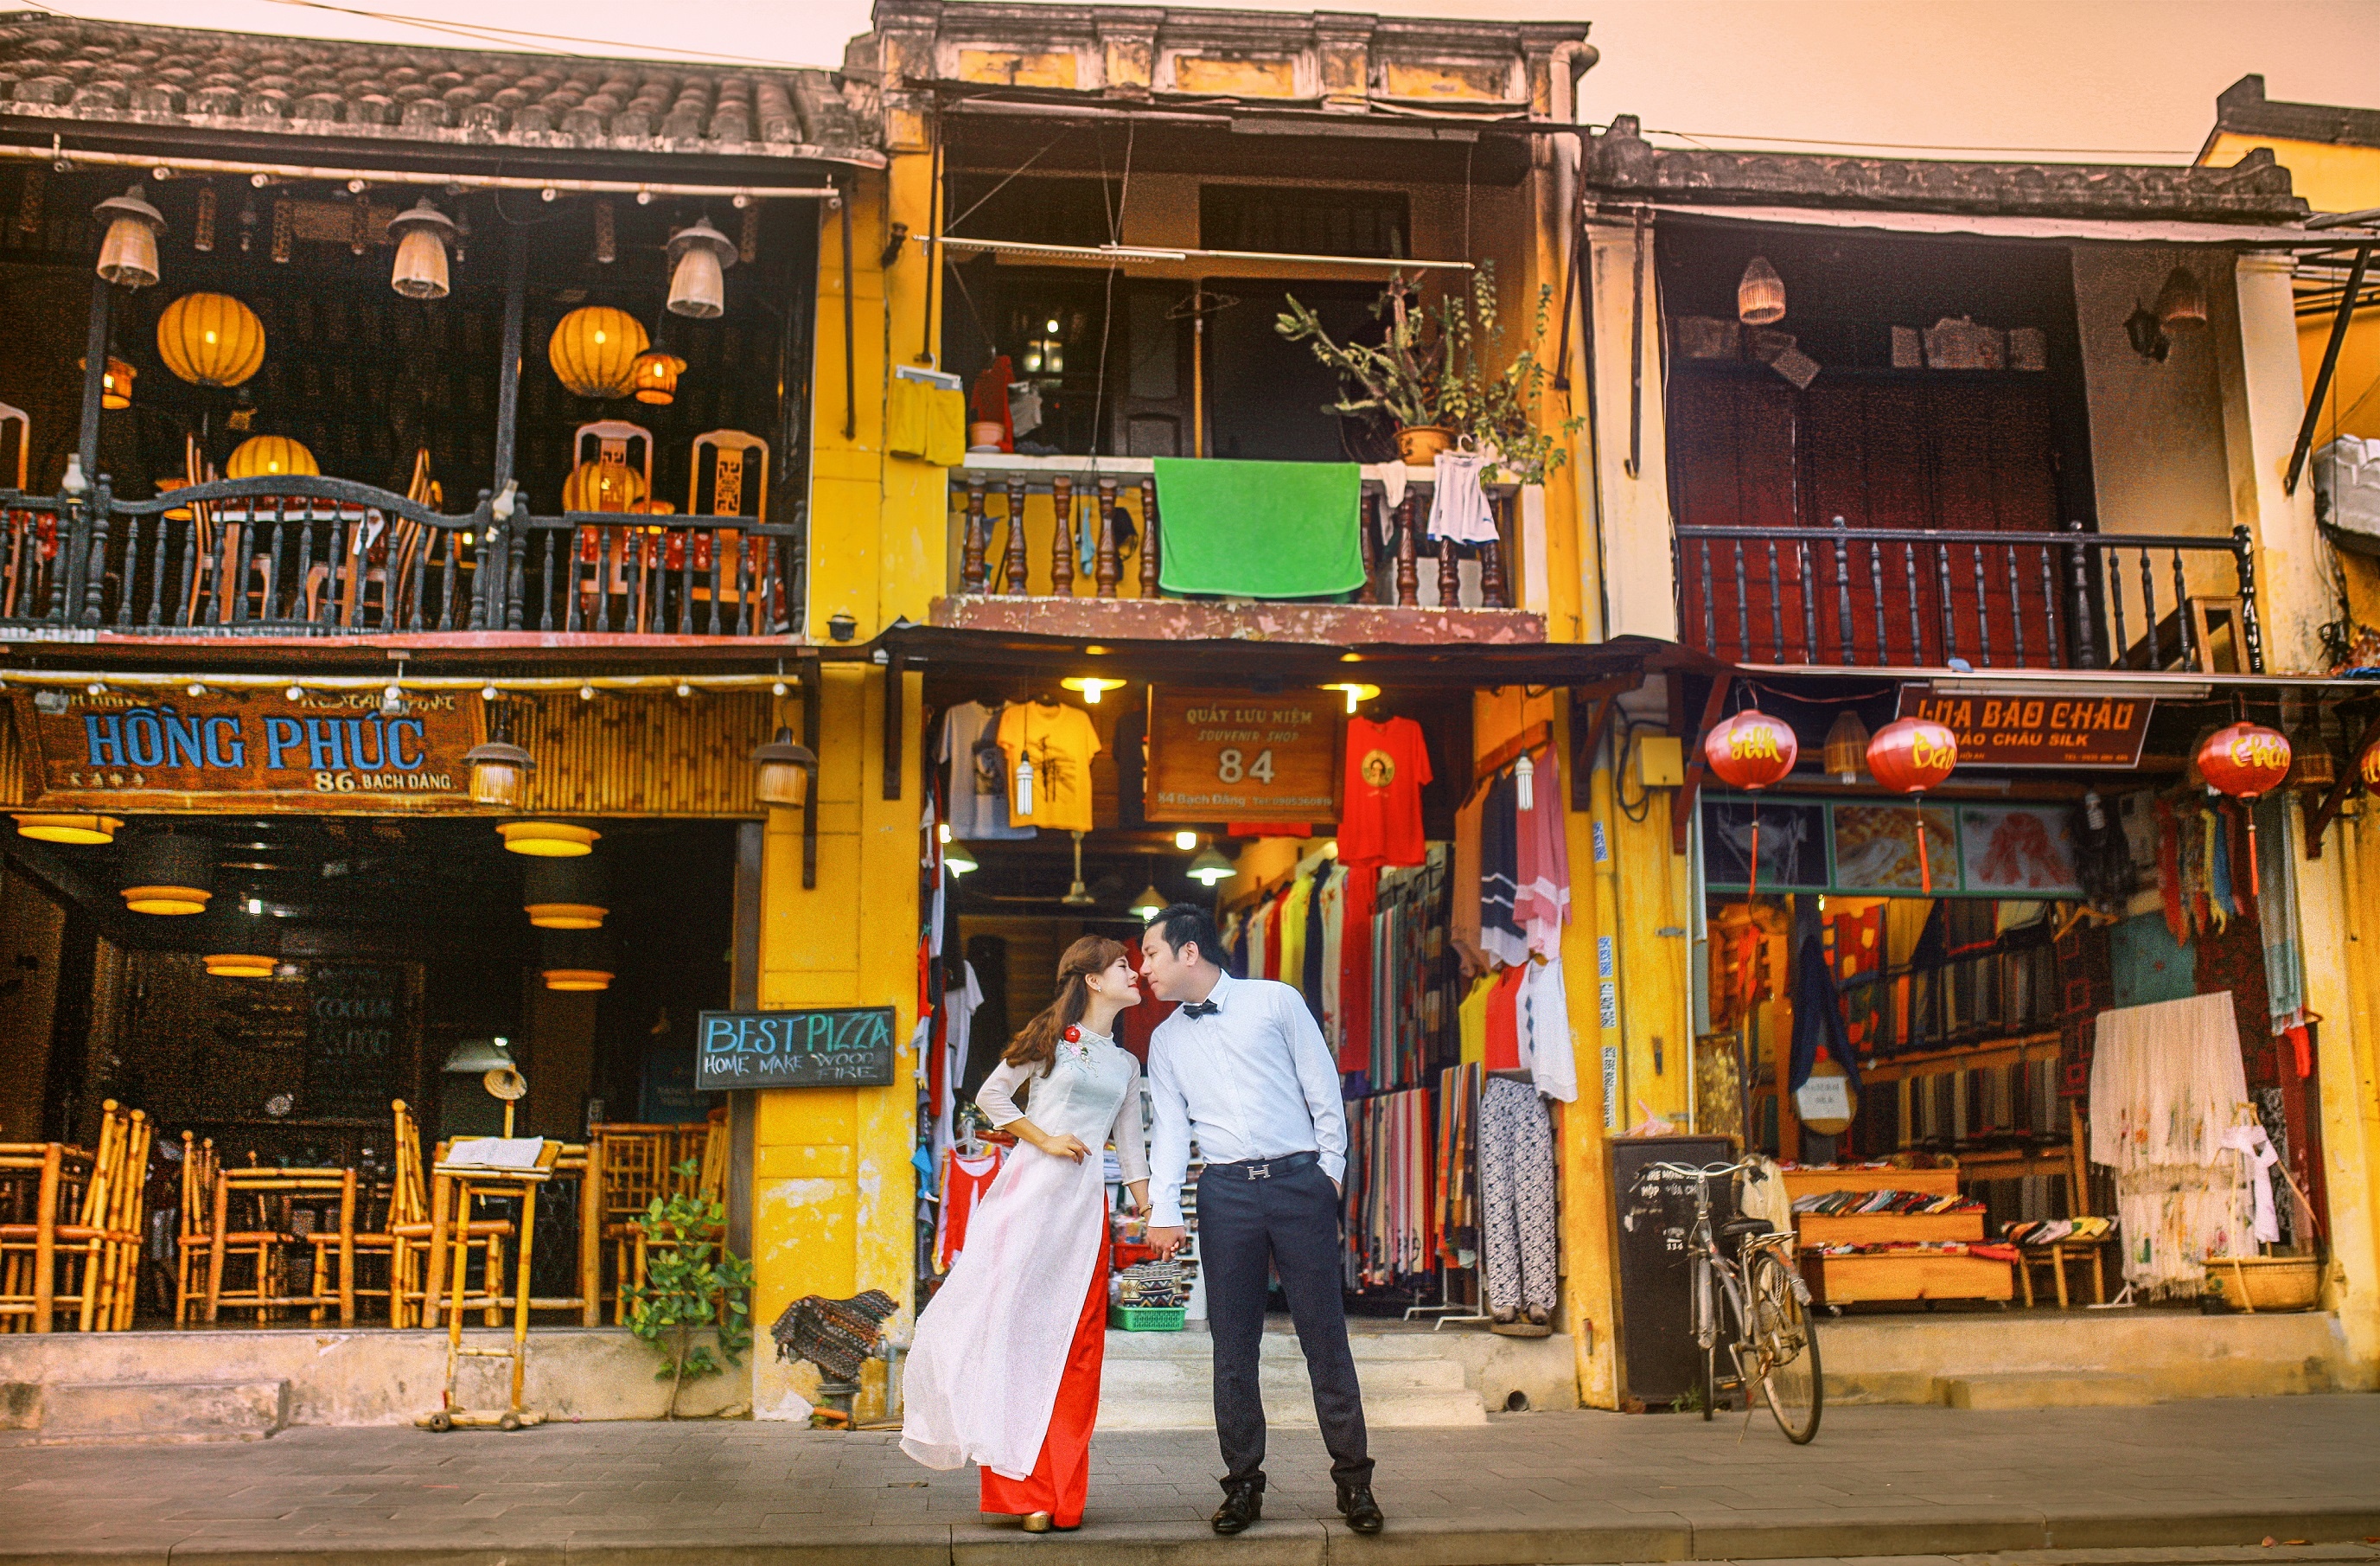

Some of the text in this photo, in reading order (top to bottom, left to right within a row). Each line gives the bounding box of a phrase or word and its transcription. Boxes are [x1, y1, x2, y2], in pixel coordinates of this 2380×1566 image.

[84, 706, 424, 770] HỒNG PHÚC
[1198, 731, 1299, 742] SOUVENIR SHOP
[1993, 731, 2043, 746] CHÂU
[2049, 733, 2089, 746] SILK
[1218, 749, 1275, 784] 84
[706, 1012, 890, 1054] BEST PIZZA
[705, 1053, 750, 1077] HOME
[759, 1053, 804, 1076] MAKE
